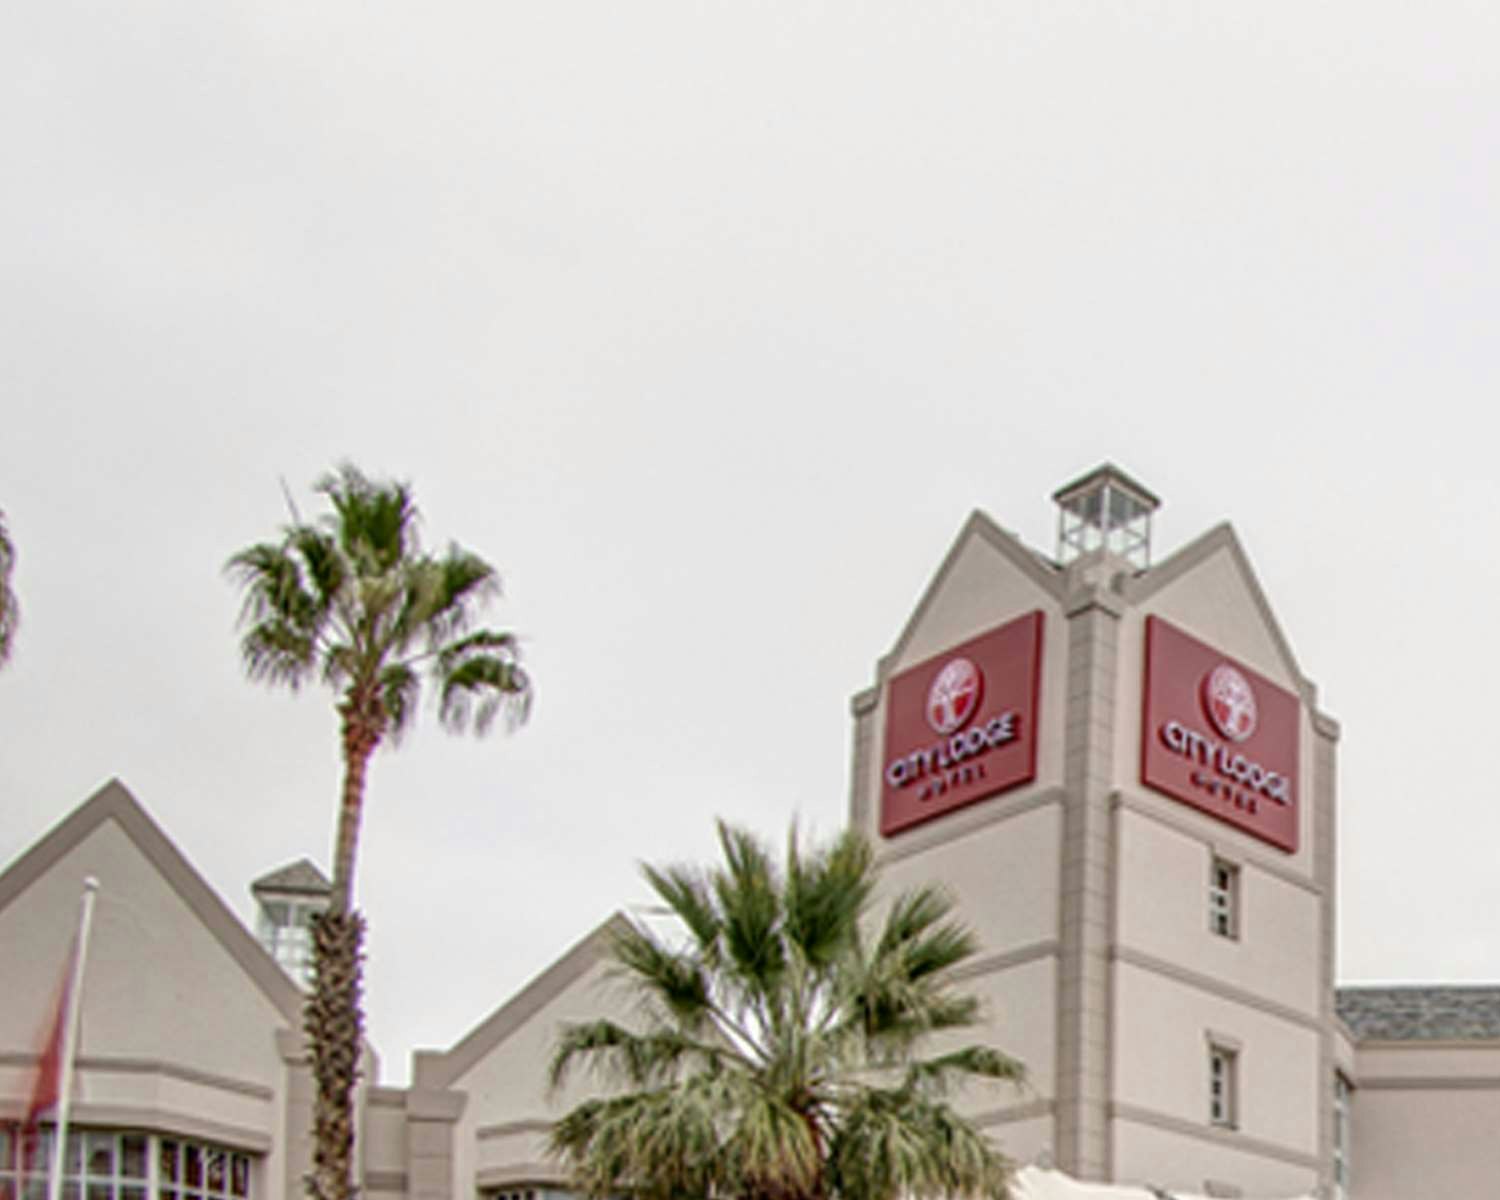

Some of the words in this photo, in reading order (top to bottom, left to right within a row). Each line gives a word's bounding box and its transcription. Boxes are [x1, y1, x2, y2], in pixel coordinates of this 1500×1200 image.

[885, 746, 940, 788] CITY
[938, 712, 1015, 768] LODGE
[1163, 720, 1217, 769] CITY
[1217, 743, 1292, 806] LODGE
